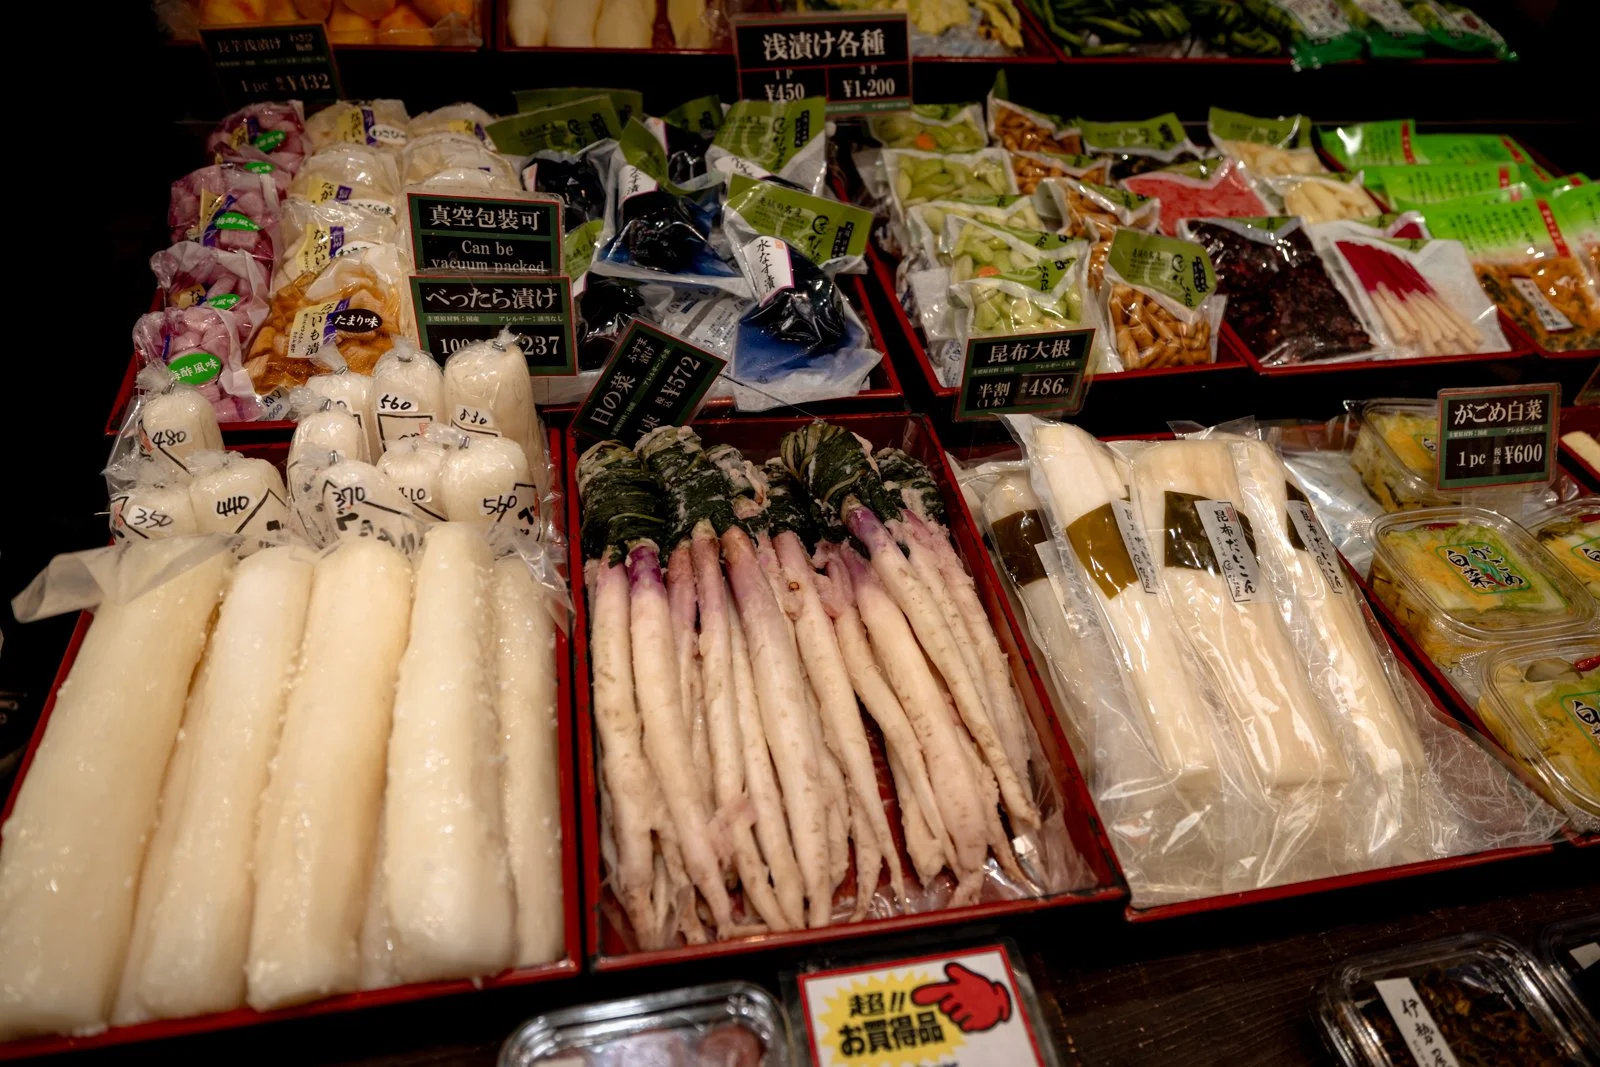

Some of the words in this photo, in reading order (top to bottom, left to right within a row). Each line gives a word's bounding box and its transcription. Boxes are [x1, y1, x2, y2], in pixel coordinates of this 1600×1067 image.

[762, 27, 886, 61] 浅漬け各種
[764, 83, 806, 102] ¥450
[842, 78, 896, 98] ¥1,200
[428, 204, 541, 232] 真空包装可
[461, 240, 490, 254] Can
[495, 242, 514, 256] be
[432, 258, 488, 271] vacuum
[493, 260, 544, 275] packed
[425, 287, 557, 309] べったら漬け
[334, 315, 379, 328] たまり味
[521, 336, 559, 356] 237
[627, 337, 649, 363] ふすま
[640, 346, 656, 365] 漬け
[987, 339, 1071, 364] 昆布大根
[660, 356, 701, 399] ¥572
[589, 371, 637, 426] 日の菜
[976, 381, 1011, 399] 半割
[380, 394, 412, 410] 560
[1454, 399, 1544, 425] がごめ白菜
[152, 430, 187, 447] 480
[1456, 451, 1467, 466] 1
[1470, 453, 1487, 468] pc
[1504, 443, 1543, 465] ¥600
[216, 496, 250, 517] 440
[332, 486, 366, 508] 370
[483, 494, 517, 515] 560
[134, 508, 173, 528] 350
[1213, 510, 1256, 594] 昆布だいこん
[838, 1012, 945, 1056] お買得品
